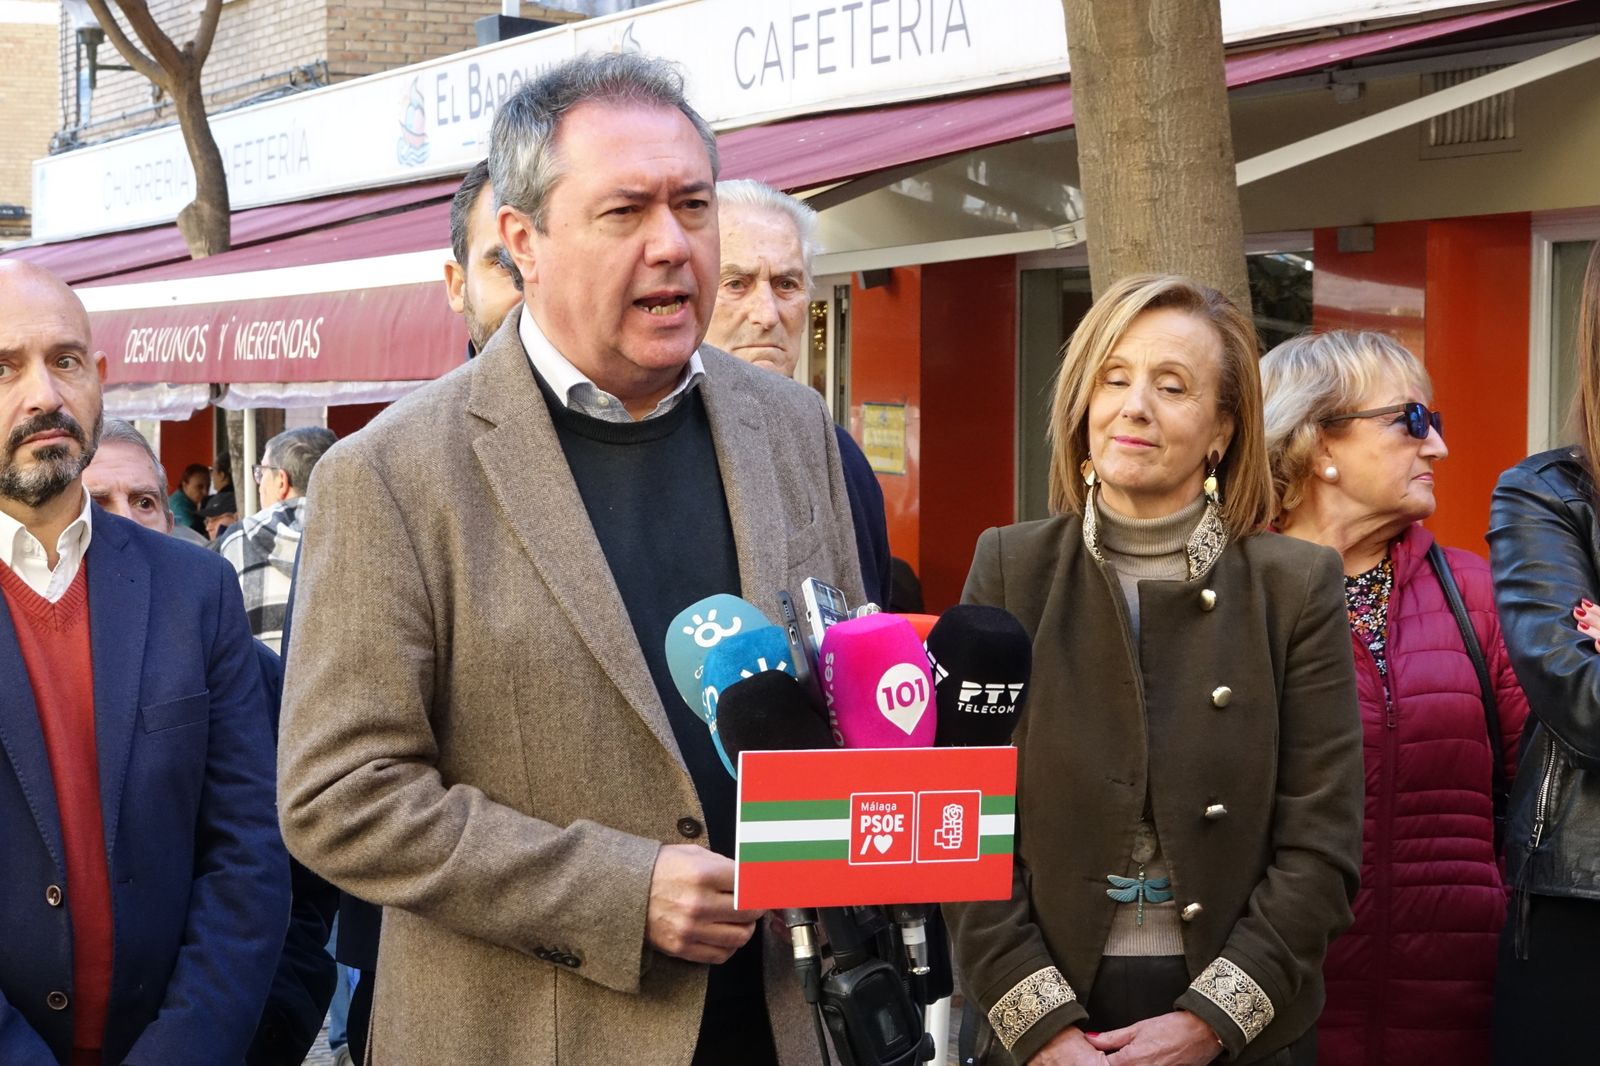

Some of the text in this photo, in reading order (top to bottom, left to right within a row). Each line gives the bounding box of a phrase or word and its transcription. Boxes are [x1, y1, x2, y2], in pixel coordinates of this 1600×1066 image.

[436, 72, 461, 126] EL
[124, 317, 324, 364] DESAYUNOS Y MERIENDAS
[881, 678, 925, 711] 101
[959, 681, 1024, 704] PTV
[957, 702, 1015, 714] TELECOM
[861, 801, 897, 812] Málaga
[860, 814, 904, 833] PSOE
